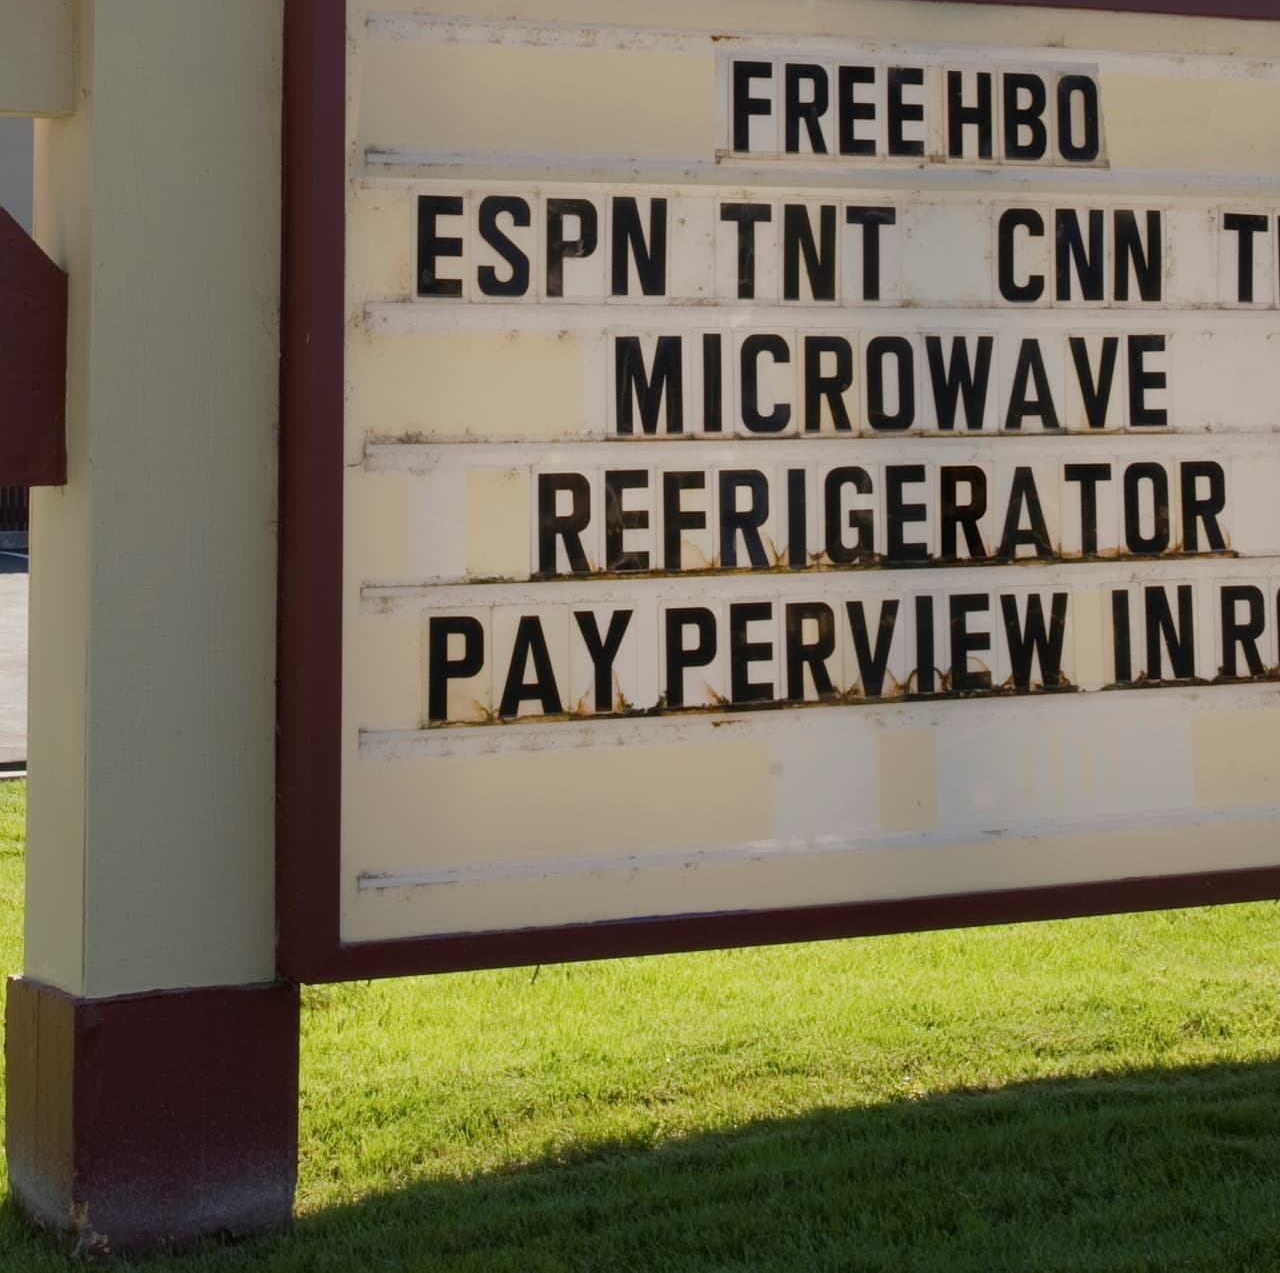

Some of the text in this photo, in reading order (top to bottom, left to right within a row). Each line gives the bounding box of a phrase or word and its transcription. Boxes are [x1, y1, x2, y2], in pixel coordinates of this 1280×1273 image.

[732, 60, 1100, 162] FREE HBO
[417, 194, 667, 298] ESPN
[720, 202, 897, 301] TNT
[997, 207, 1162, 302] CNN
[614, 332, 1168, 435] MICROWAVE
[536, 460, 1226, 575] REFRIGERATOR
[428, 608, 634, 722] PAY
